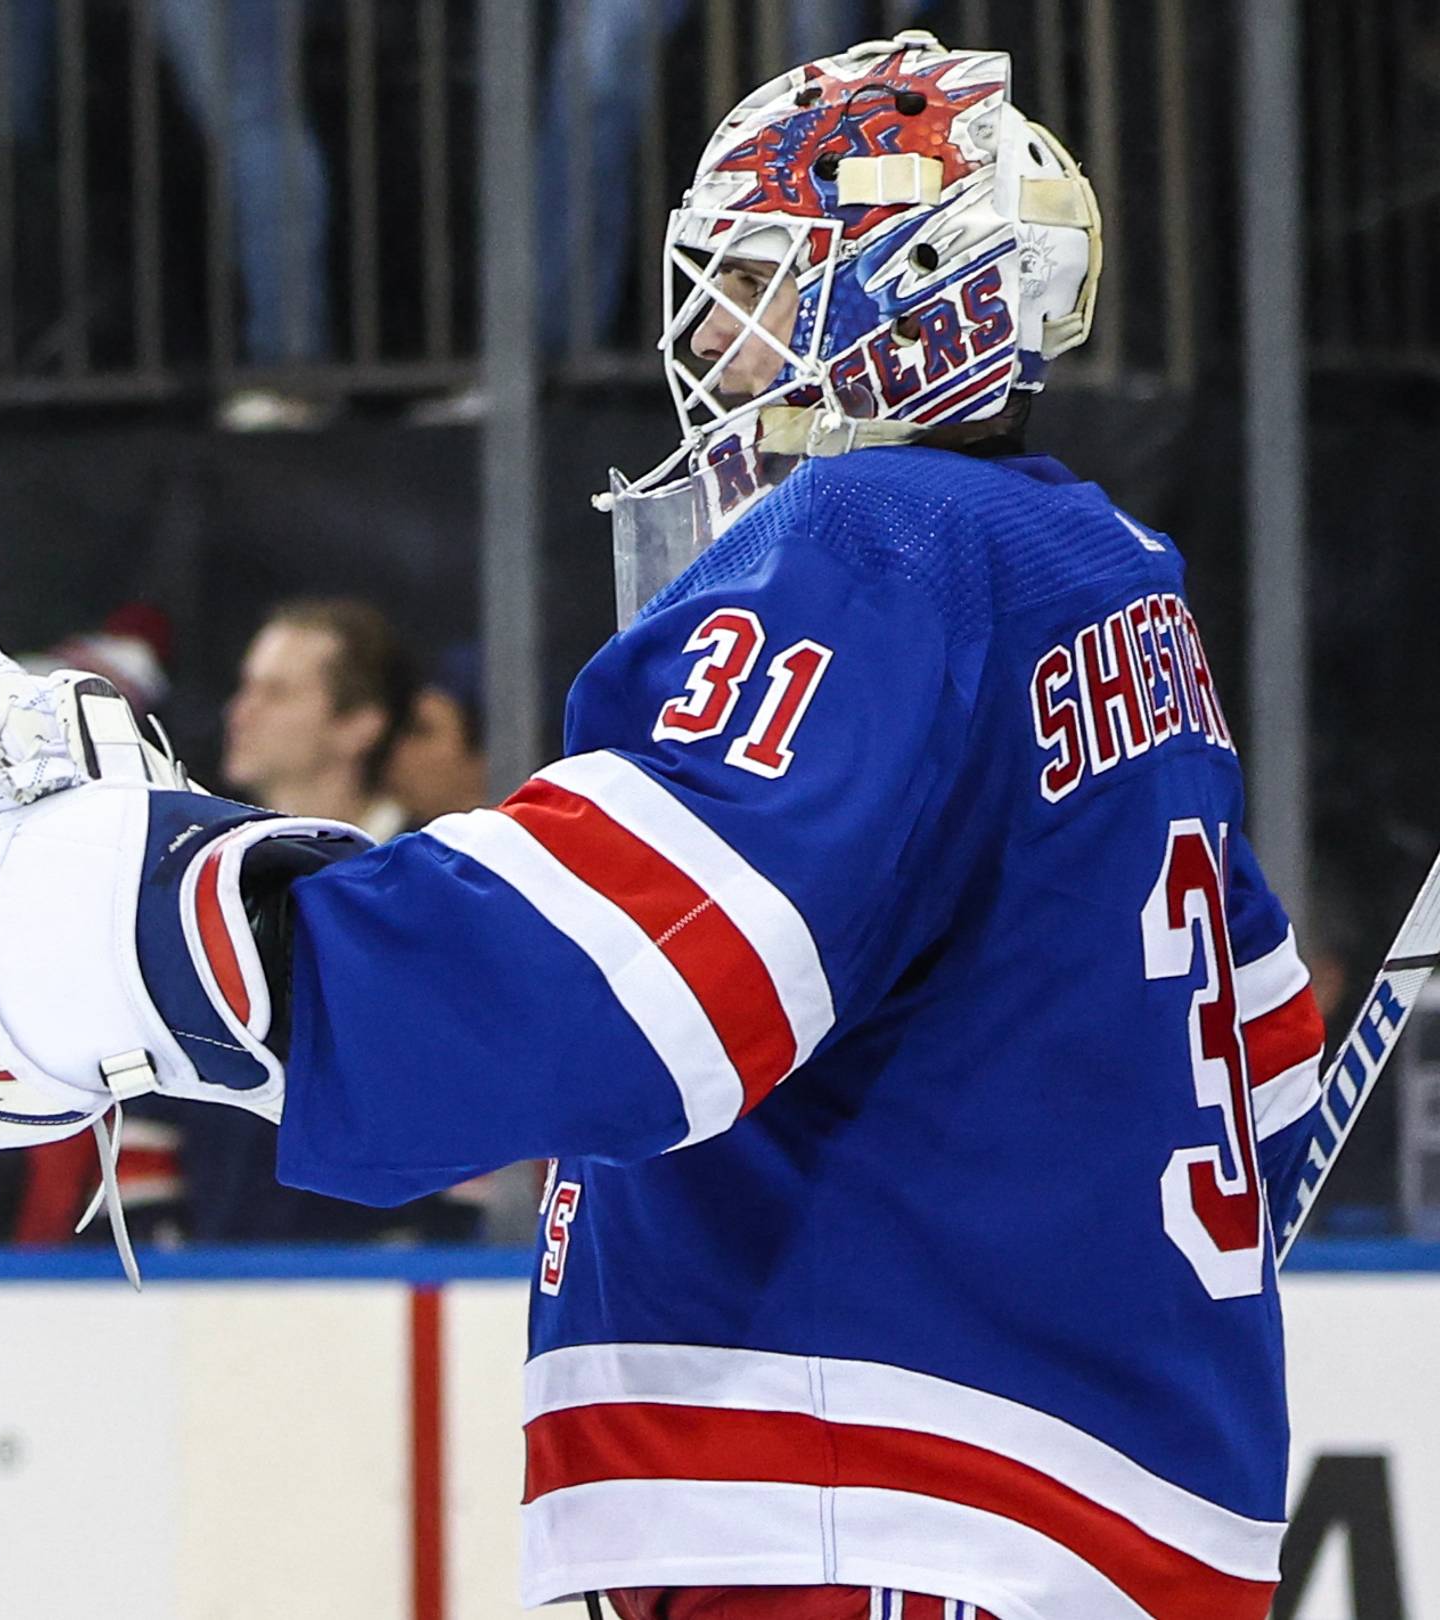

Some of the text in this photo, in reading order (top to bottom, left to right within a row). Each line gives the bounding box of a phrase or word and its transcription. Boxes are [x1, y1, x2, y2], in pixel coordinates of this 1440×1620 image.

[651, 607, 835, 780] 31
[1140, 817, 1263, 1301] 3
[539, 1157, 582, 1297] S
